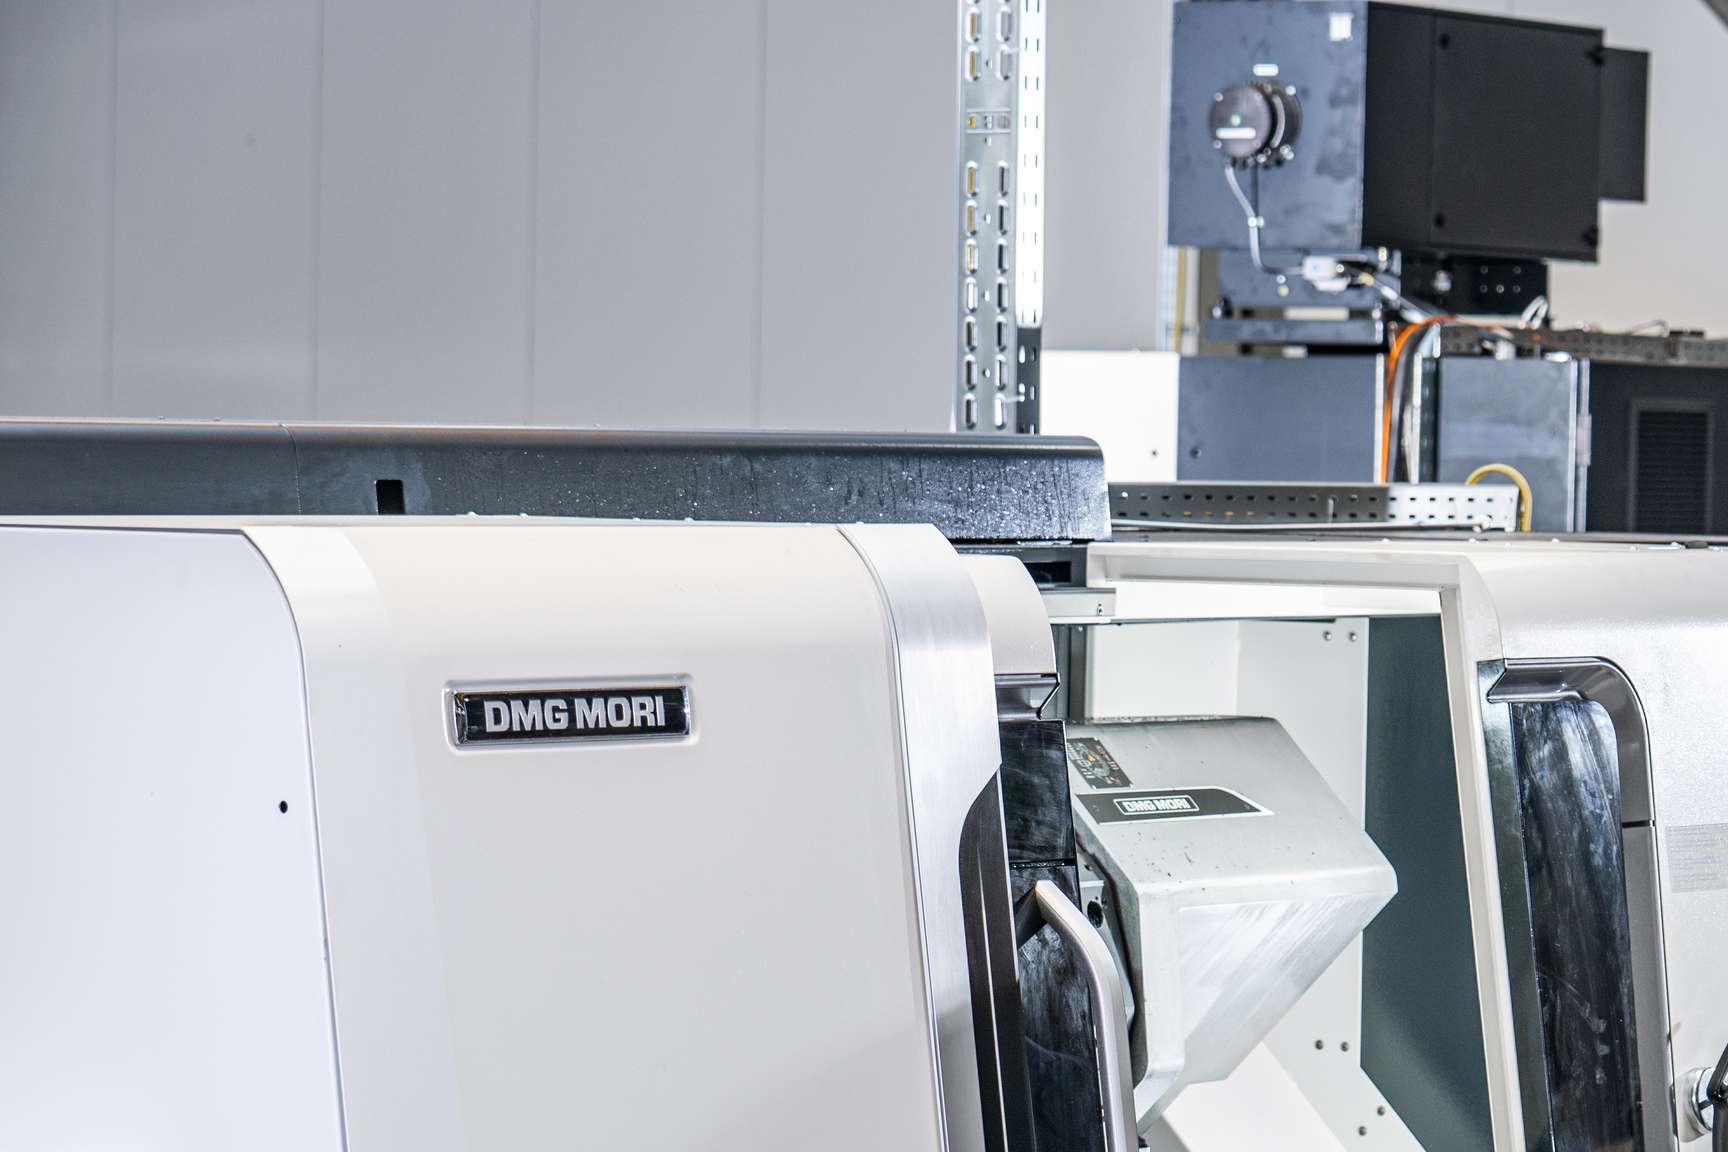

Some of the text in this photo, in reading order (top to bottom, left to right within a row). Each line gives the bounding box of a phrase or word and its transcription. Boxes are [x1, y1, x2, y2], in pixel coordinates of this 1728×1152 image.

[483, 695, 667, 733] DMG MORI
[1121, 798, 1192, 813] DMG MORI
